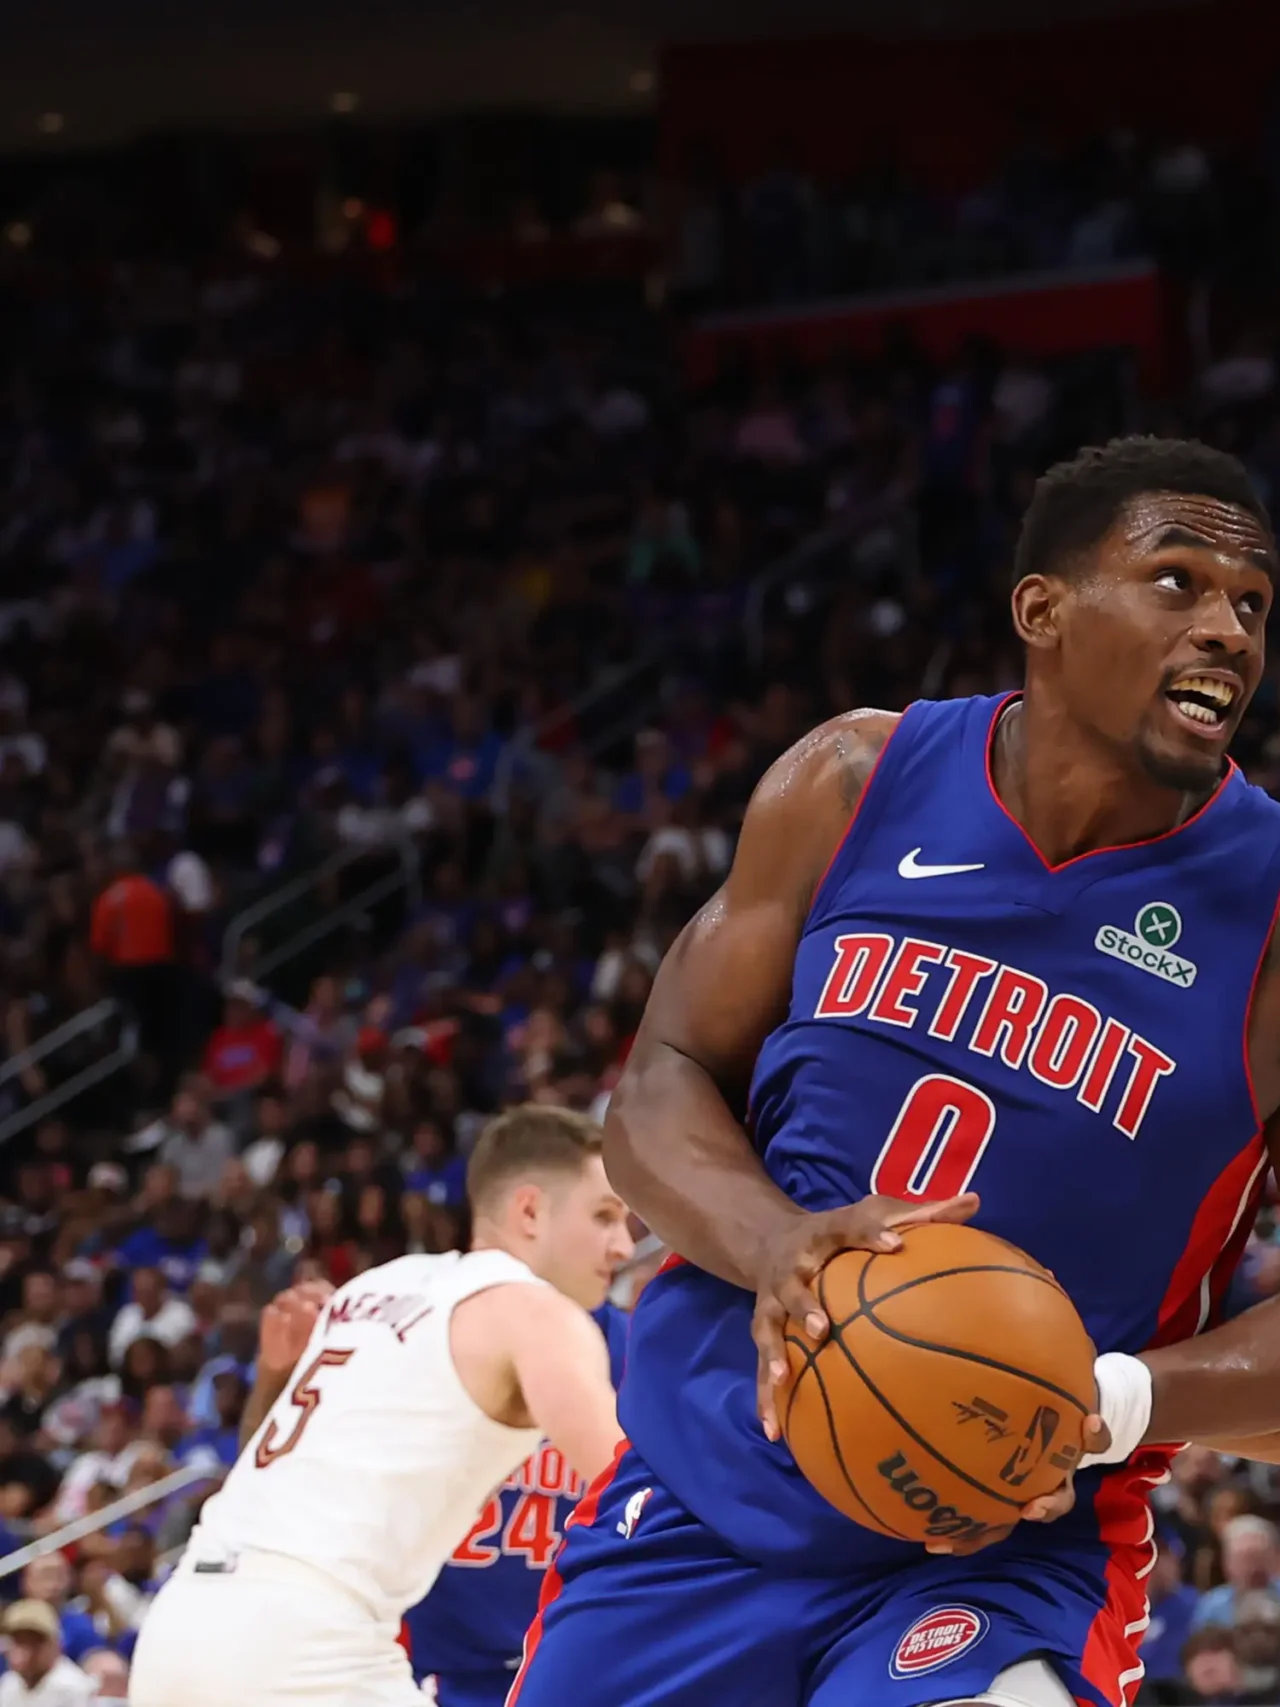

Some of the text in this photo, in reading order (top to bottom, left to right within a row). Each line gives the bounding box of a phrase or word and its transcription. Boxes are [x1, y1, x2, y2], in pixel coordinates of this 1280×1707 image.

[1100, 929, 1194, 985] StockX
[813, 932, 1177, 1141] DETROIT
[869, 1072, 997, 1204] 0
[254, 1348, 356, 1469] 5
[448, 1493, 563, 1570] 24
[903, 1632, 964, 1658] PISTONS
[908, 1622, 969, 1647] DETROIT
